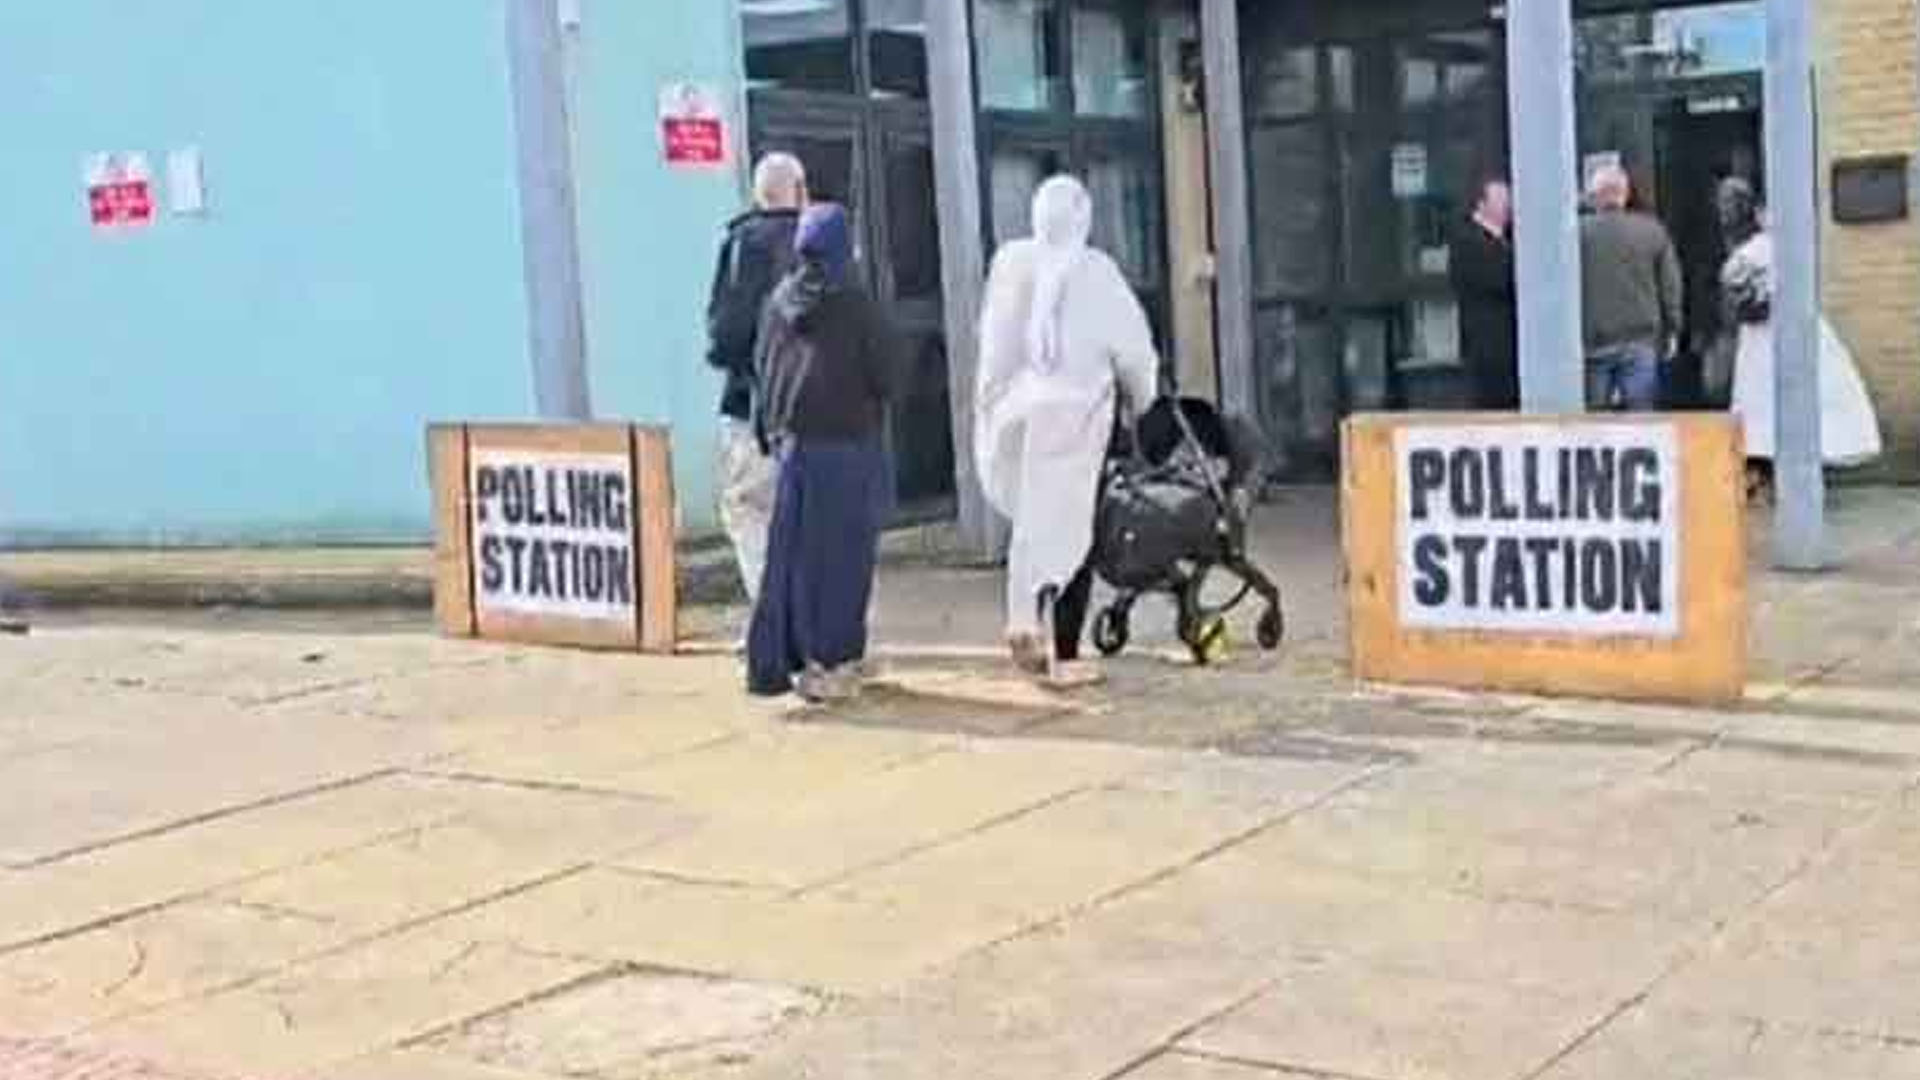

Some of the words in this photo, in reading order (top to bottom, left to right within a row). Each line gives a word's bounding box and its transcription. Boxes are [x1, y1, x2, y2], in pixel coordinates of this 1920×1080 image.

[477, 465, 626, 532] POLLING
[1409, 447, 1661, 522] POLLING
[480, 534, 631, 603] STATION
[1412, 534, 1662, 614] STATION
